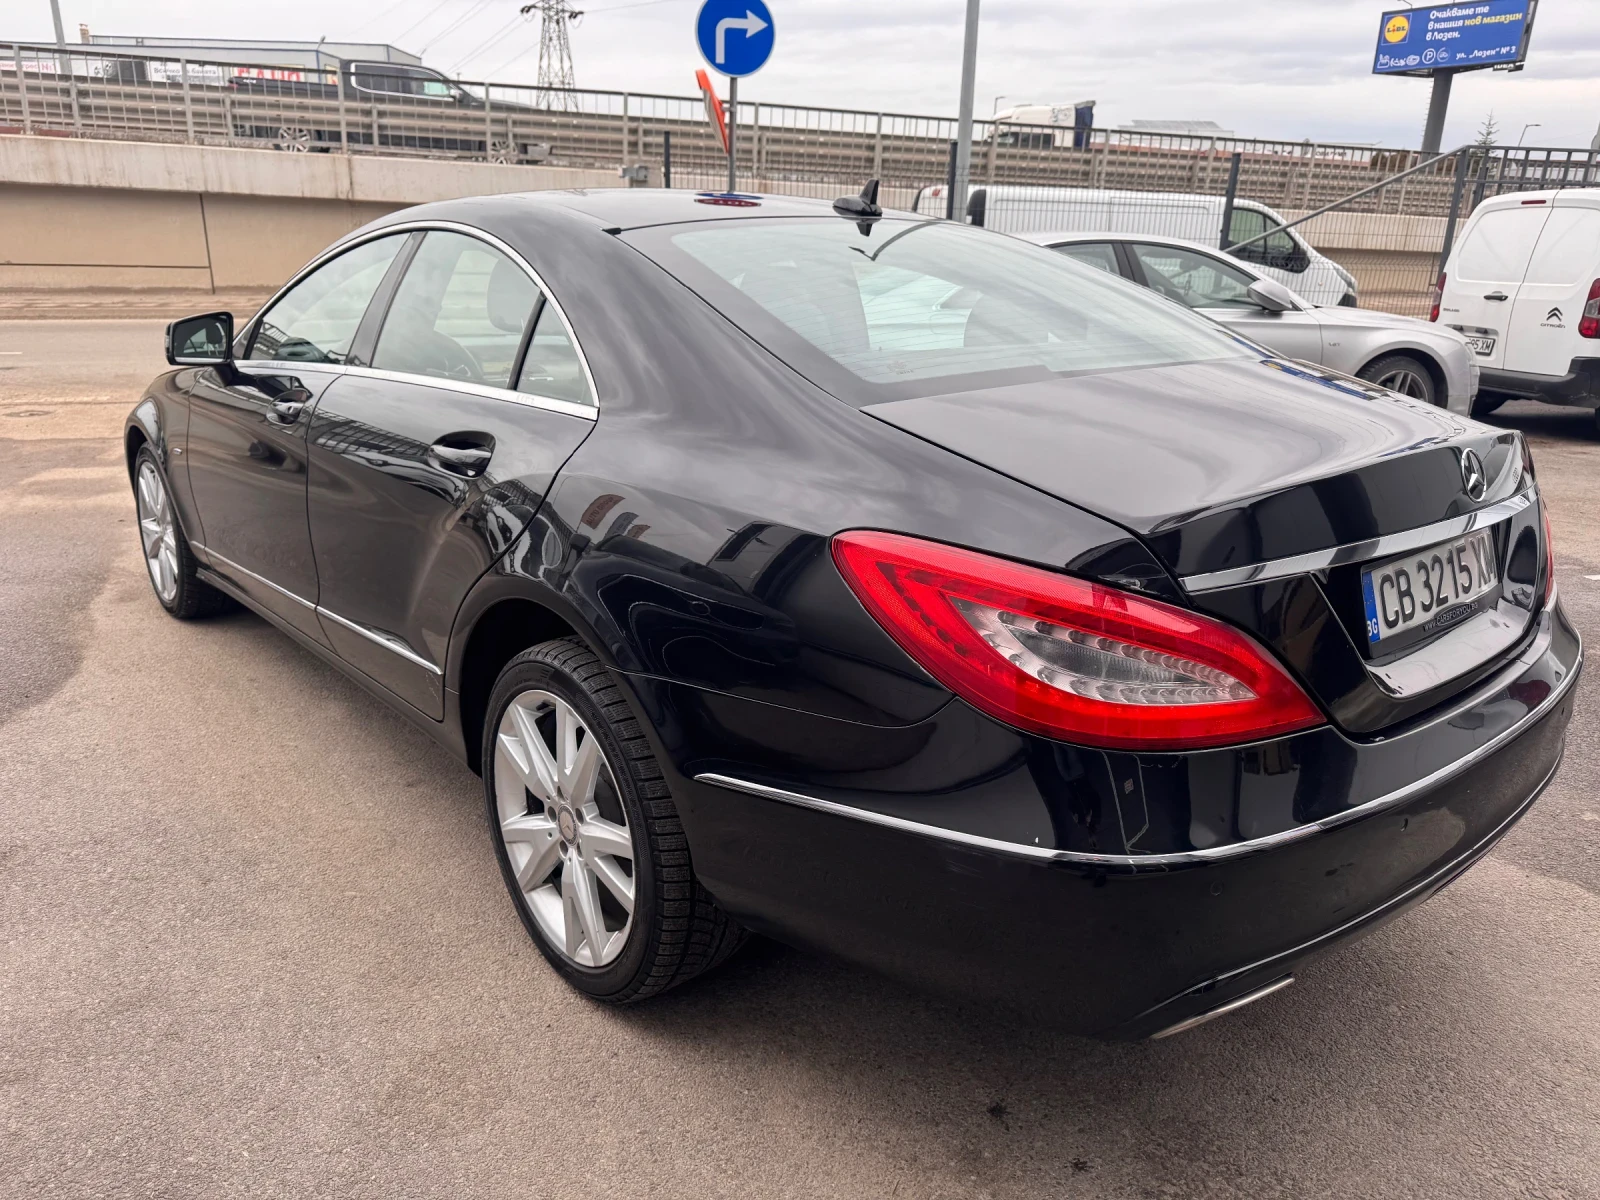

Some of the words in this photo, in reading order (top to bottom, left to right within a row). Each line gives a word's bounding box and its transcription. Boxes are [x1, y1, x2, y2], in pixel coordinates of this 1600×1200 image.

[1430, 7, 1474, 19] Очакваме
[1475, 5, 1490, 14] те
[1434, 19, 1463, 29] нашия
[1464, 15, 1482, 26] нов
[1482, 12, 1523, 24] магазин
[1432, 30, 1461, 41] Лозен.
[1380, 566, 1415, 629] CB
[1417, 543, 1472, 612] 3215
